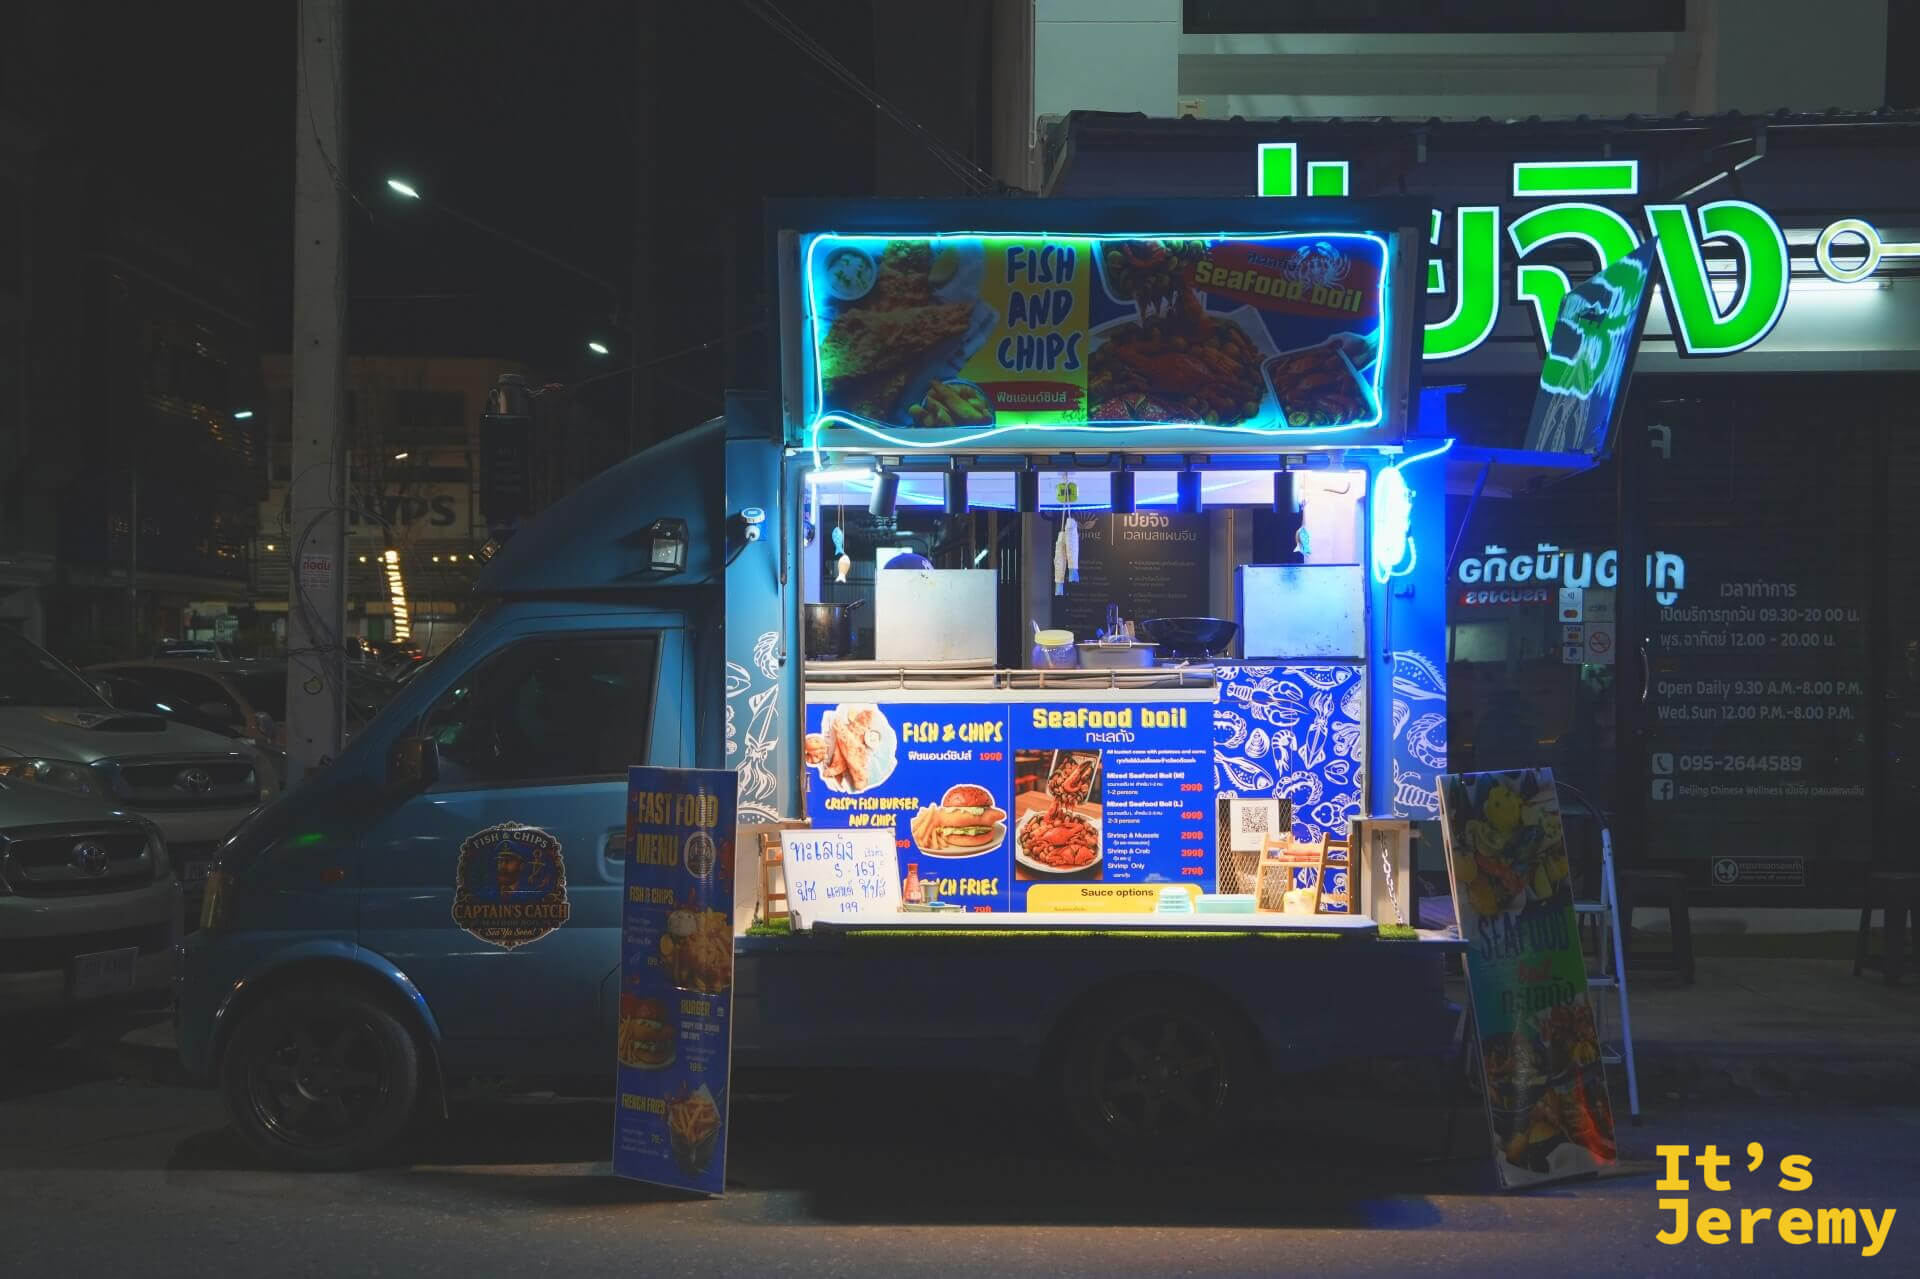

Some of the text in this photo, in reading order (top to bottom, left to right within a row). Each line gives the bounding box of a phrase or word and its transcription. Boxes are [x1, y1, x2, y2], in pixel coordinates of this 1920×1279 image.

[1006, 244, 1076, 284] FISH
[1195, 260, 1362, 313] Seafood boil
[1008, 288, 1073, 329] AND
[998, 331, 1082, 371] CHIPS
[1720, 577, 1798, 599] เวลาทำการ
[1660, 605, 1756, 626] เปิดบริการทุกวัน
[1847, 607, 1861, 622] น.
[1731, 632, 1766, 647] 12.00
[1780, 632, 1820, 647] 20.00
[1823, 633, 1837, 647] น.
[1657, 681, 1693, 698] Open
[1696, 680, 1731, 699] Daily
[1734, 681, 1763, 695] 9.30
[1836, 681, 1864, 695] P.M.
[1033, 707, 1187, 728] Seafood boil
[1721, 706, 1756, 720] 12.00
[1827, 706, 1855, 720] P.M.
[902, 721, 1003, 743] FISH & CHIPS
[1085, 730, 1135, 743] ทะเลถัง
[1680, 755, 1803, 772] 095-2644589
[637, 790, 719, 829] FAST FOOD
[825, 797, 919, 810] CRISPY FISH BURGER
[849, 813, 896, 827] AND CHIPS
[473, 831, 548, 849] FISH & CHIPS
[635, 832, 680, 867] MENU
[854, 860, 876, 877] 169
[1131, 862, 1145, 870] Only
[629, 885, 645, 902] FISH
[651, 887, 674, 904] CHIPS
[960, 877, 998, 896] FRIES
[1080, 887, 1154, 898] Sauce options
[454, 903, 568, 919] CAPTAIN'S CATCH
[840, 901, 858, 912] 199
[1478, 910, 1569, 962] SEAFOOD
